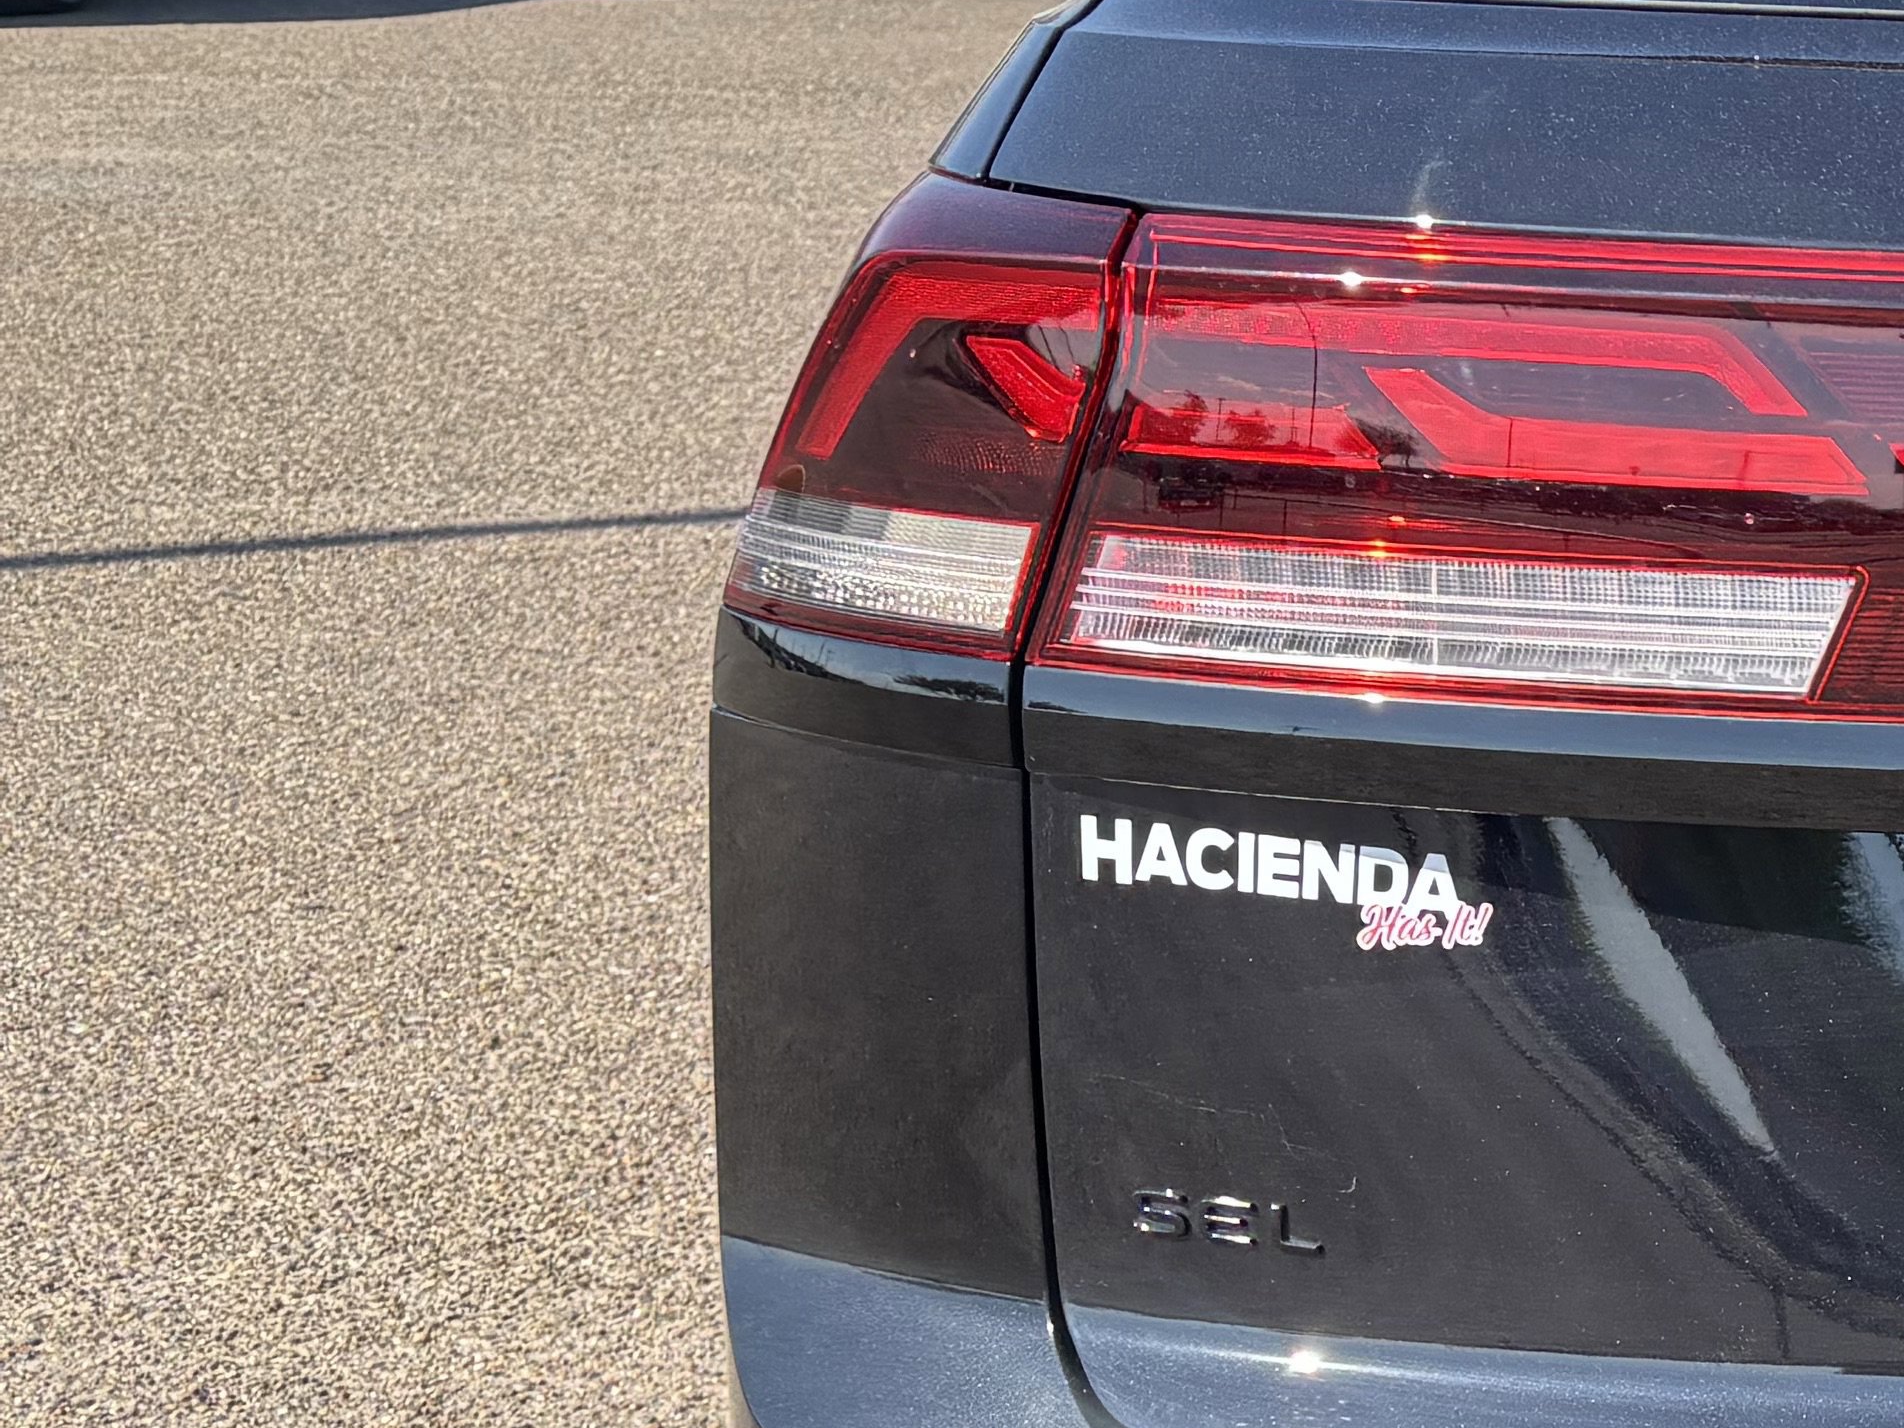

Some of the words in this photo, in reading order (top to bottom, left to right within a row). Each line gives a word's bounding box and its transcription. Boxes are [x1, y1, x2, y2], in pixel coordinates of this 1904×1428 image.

[1079, 814, 1461, 918] HACIENDA
[1356, 903, 1443, 951] Has
[1441, 901, 1494, 950] It!
[1132, 1187, 1327, 1256] SEL
